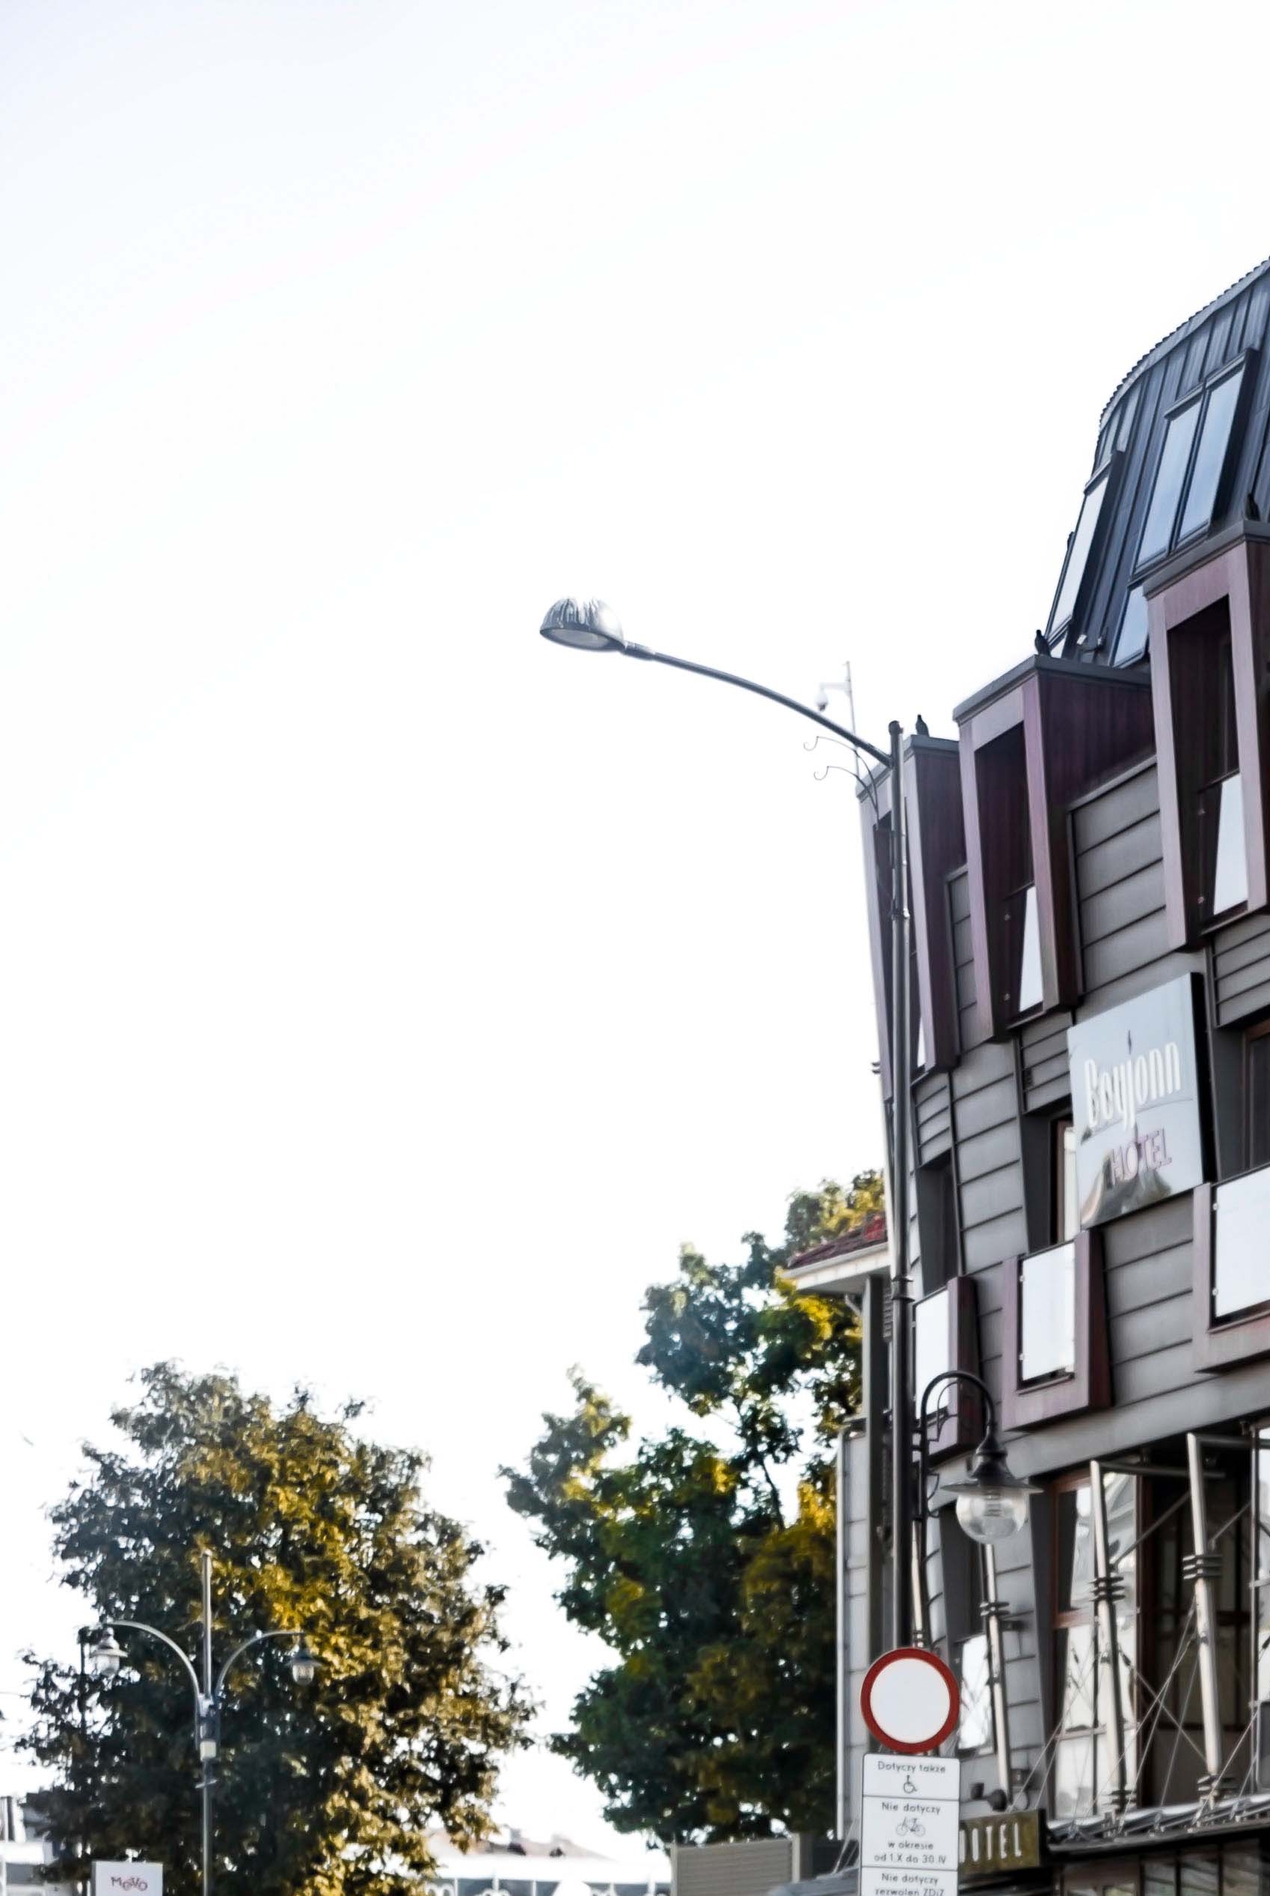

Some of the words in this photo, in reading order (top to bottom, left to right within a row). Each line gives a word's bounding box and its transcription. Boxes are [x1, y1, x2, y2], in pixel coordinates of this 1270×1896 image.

[1110, 1127, 1173, 1185] HOTEL
[877, 1760, 917, 1774] Dotyczy
[881, 1801, 899, 1812] Nie
[903, 1803, 941, 1815] dotyczy
[898, 1840, 934, 1850] okresie
[873, 1853, 887, 1862] od
[906, 1854, 919, 1864] do
[881, 1872, 899, 1883] Nie
[901, 1873, 939, 1886] dotyczy
